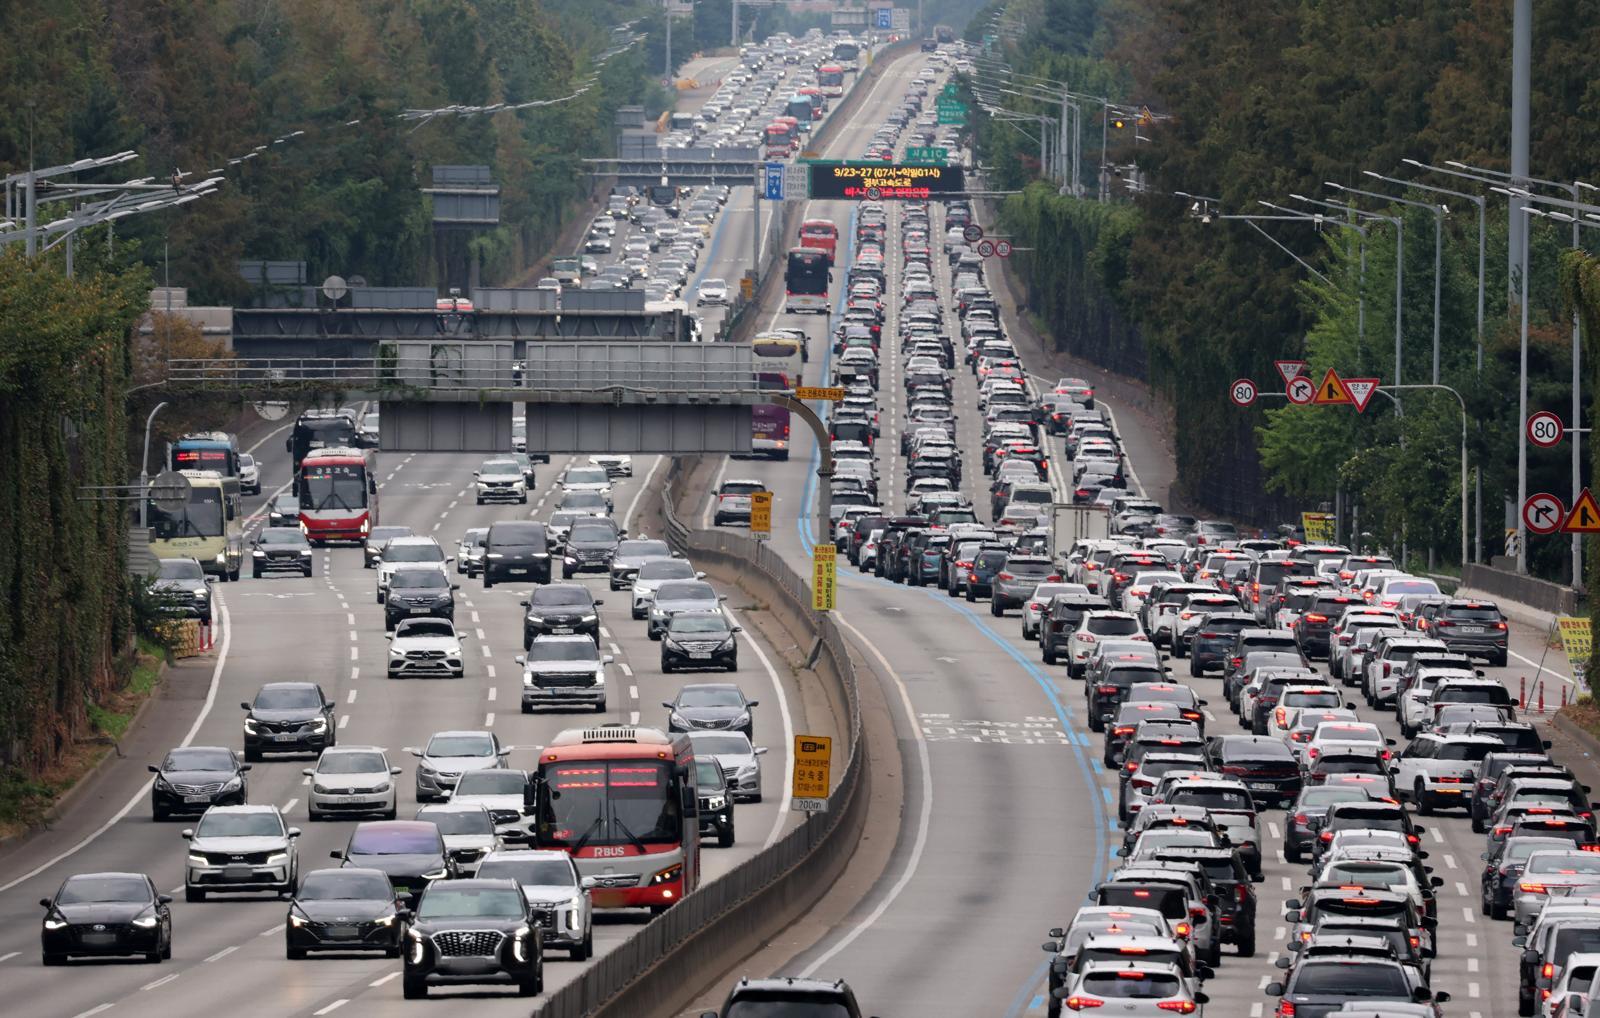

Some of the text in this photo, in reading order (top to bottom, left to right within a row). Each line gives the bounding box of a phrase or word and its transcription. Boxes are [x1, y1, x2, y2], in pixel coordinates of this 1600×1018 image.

[863, 178, 912, 188] 경부고속도로
[1236, 386, 1252, 400] 80
[1535, 421, 1556, 438] 80
